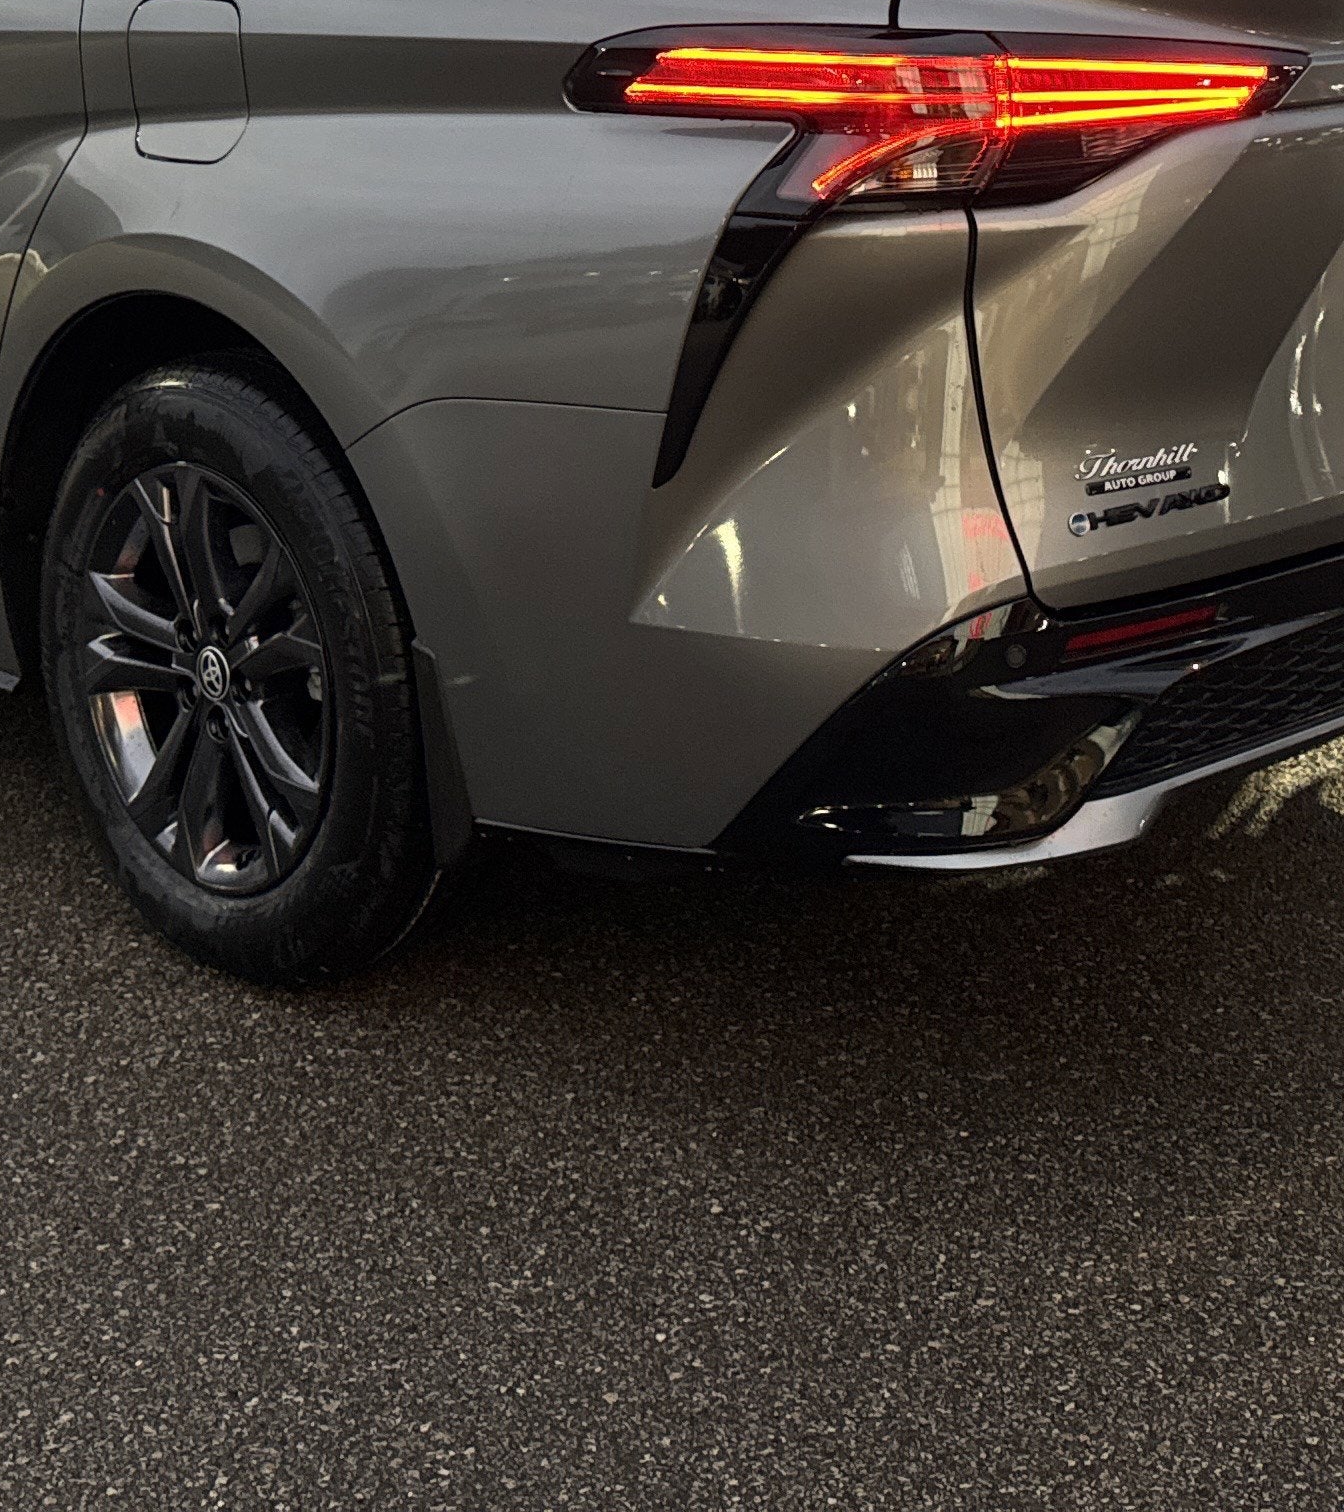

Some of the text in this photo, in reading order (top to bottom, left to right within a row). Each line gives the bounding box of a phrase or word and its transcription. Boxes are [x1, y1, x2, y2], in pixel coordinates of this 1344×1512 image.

[1074, 442, 1199, 481] Thornhill
[1104, 469, 1177, 491] AUTO GROUP
